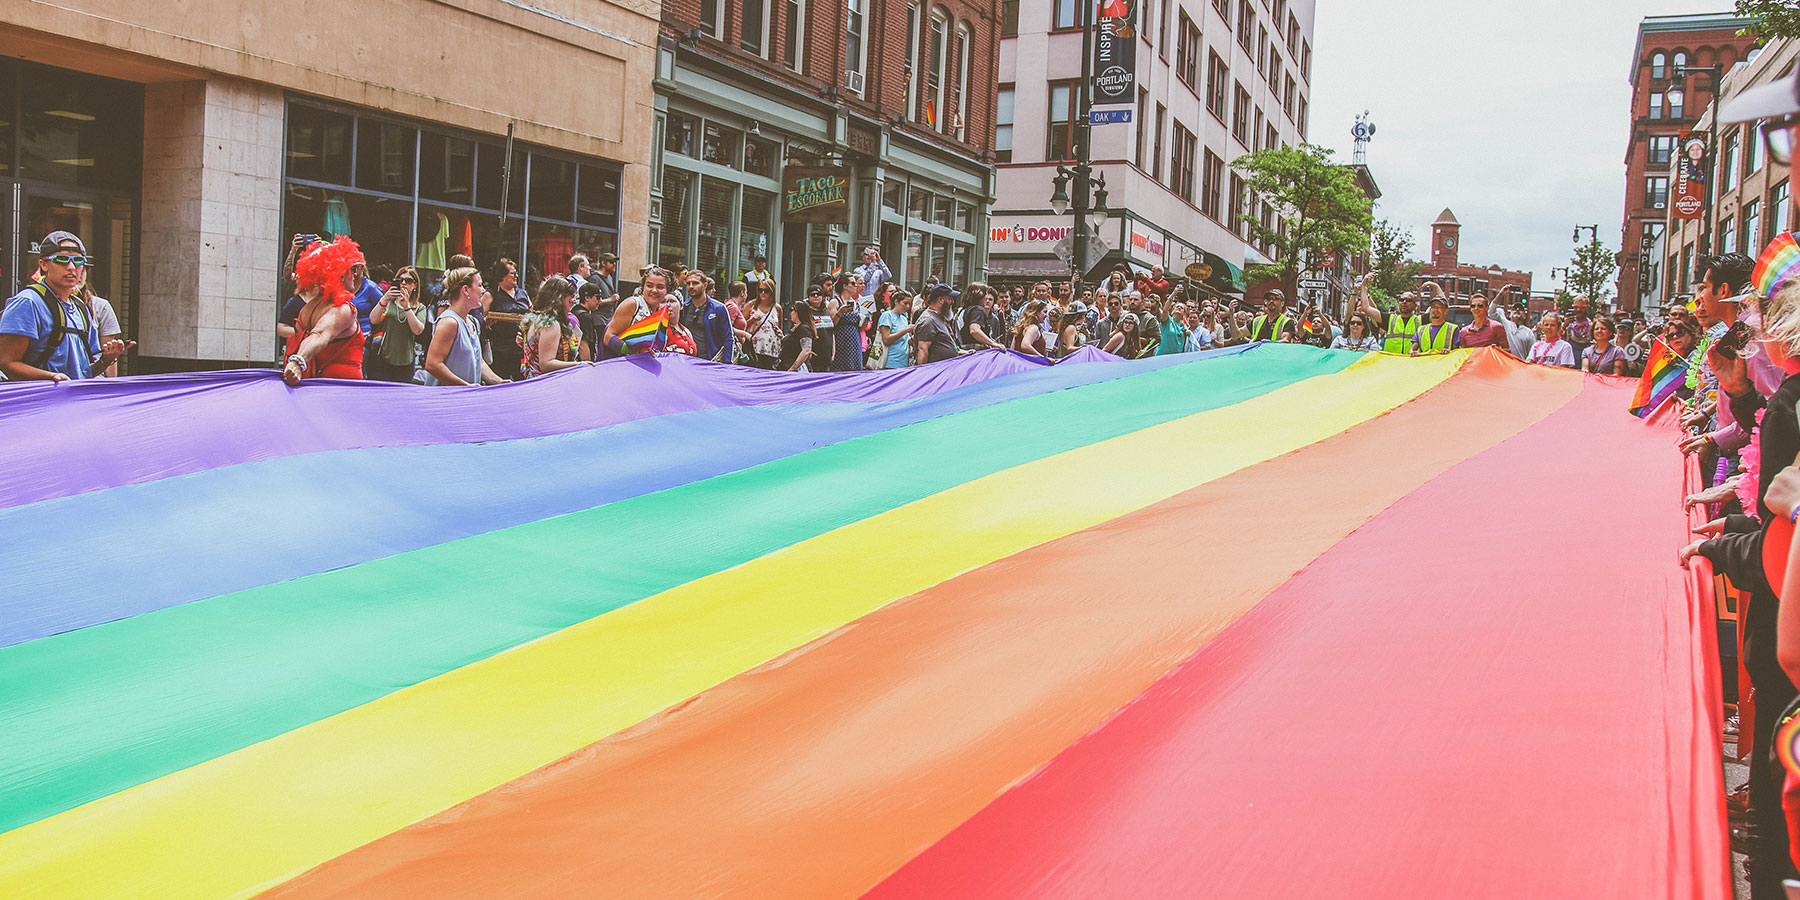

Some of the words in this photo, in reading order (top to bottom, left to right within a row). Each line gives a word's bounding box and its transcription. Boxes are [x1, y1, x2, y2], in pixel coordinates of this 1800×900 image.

[1100, 16, 1112, 62] INSPIRE
[1096, 73, 1133, 86] PORTLAND
[1094, 112, 1109, 122] OAK
[795, 175, 835, 195] TACO
[1679, 157, 1689, 194] CELEBRATE
[786, 186, 844, 211] ESCOBARR
[990, 228, 1011, 241] IN'
[1027, 227, 1073, 241] DONU
[1640, 238, 1650, 290] EMPIRE
